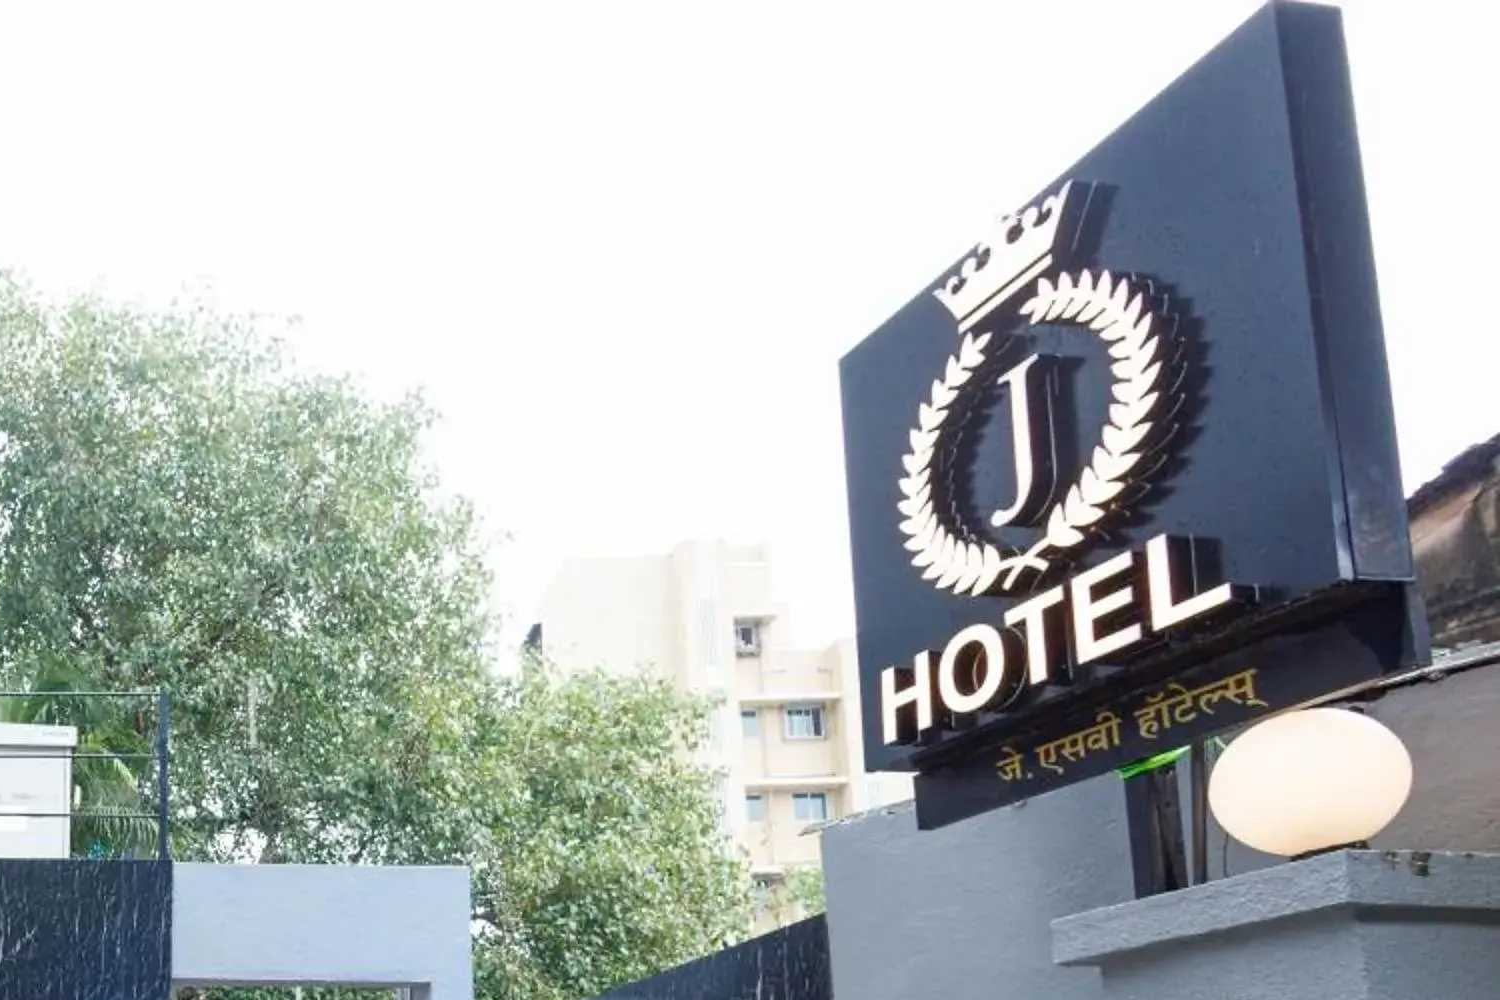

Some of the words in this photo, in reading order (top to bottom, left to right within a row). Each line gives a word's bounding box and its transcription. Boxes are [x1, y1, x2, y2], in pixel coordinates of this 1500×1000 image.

[990, 352, 1040, 529] J
[880, 533, 1233, 746] HOTEL
[1034, 710, 1123, 776] एसवी
